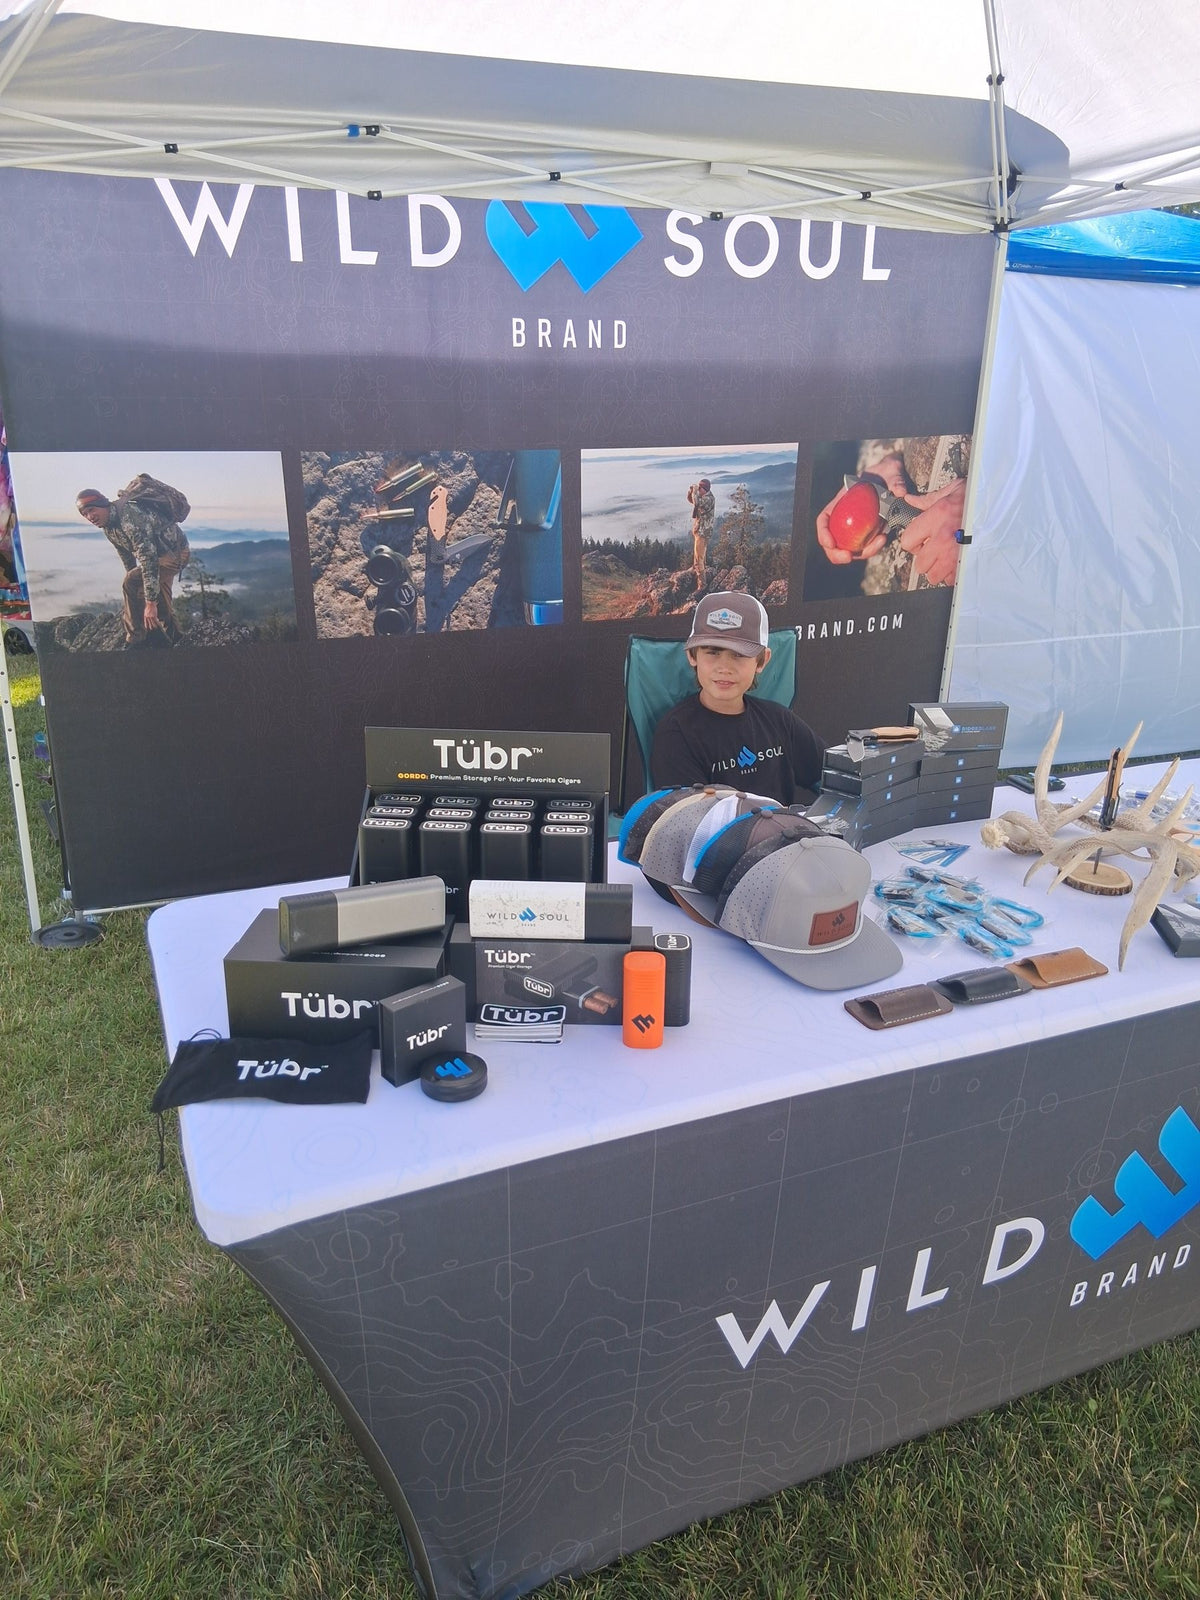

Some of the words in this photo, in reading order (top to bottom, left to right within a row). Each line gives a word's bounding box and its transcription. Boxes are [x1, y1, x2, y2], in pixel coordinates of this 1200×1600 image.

[153, 177, 462, 267] WILD
[663, 208, 892, 281] SOUL
[511, 317, 627, 349] BRAND
[430, 773, 461, 781] Premium
[462, 774, 492, 783] Storage
[507, 775, 525, 783] Your
[526, 776, 556, 784] Favorite
[557, 777, 582, 786] Cigars
[487, 912, 518, 921] WILD
[539, 913, 569, 922] SOUL
[525, 979, 550, 995] Tübr
[489, 1006, 559, 1023] Tübr
[1069, 1244, 1192, 1307] BRAND
[715, 1216, 1046, 1369] WILD
